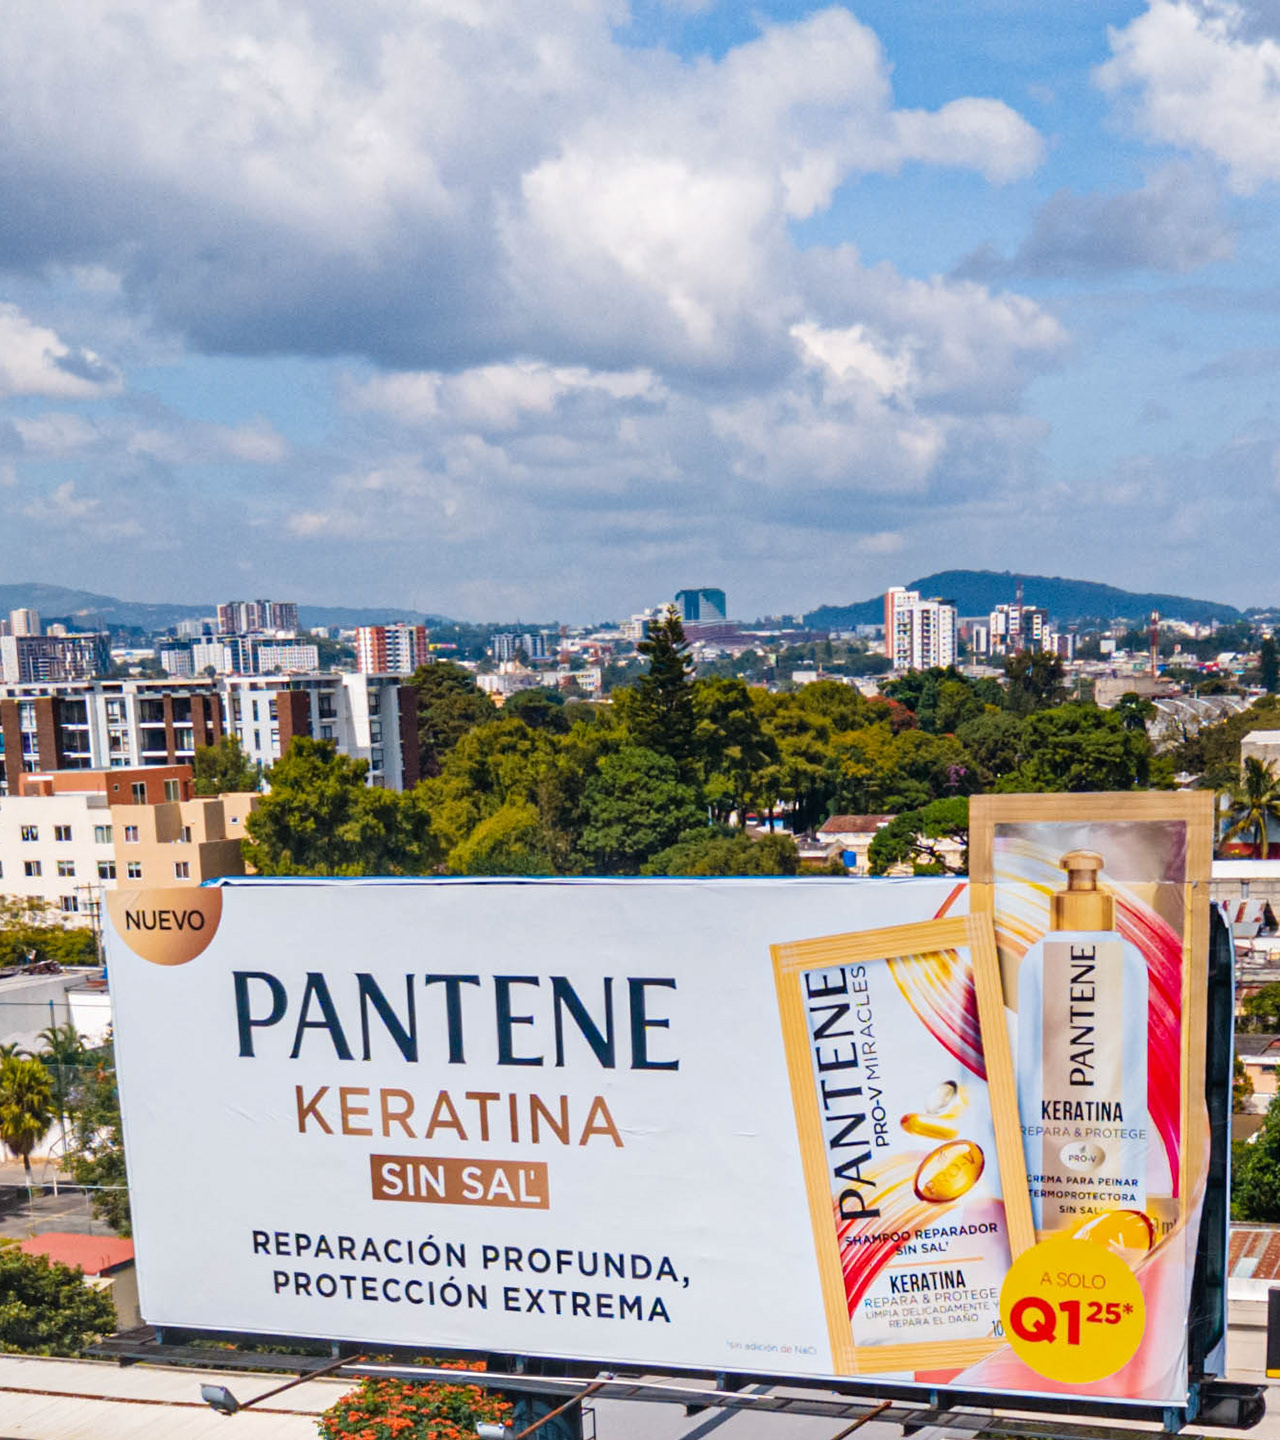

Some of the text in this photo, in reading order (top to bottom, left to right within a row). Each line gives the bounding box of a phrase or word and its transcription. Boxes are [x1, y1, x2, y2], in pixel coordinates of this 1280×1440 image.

[125, 909, 206, 932] NUEVO
[232, 970, 680, 1071] PANTENE
[1070, 945, 1096, 1086] PANTENE
[851, 965, 891, 1148] PRO-V MIRACLES
[805, 967, 881, 1221] PANTENE
[295, 1084, 625, 1148] KERATINA
[1041, 1100, 1124, 1122] KERATINA
[1020, 1125, 1147, 1140] REPARA & PROTEGE
[1068, 1154, 1098, 1164] PRO-V
[381, 1162, 446, 1198] SIN
[1066, 1175, 1094, 1186] PARA
[1098, 1177, 1139, 1187] PEINAR
[1028, 1188, 1136, 1202] TERMOPROTECTORA
[1059, 1205, 1077, 1214] SIN
[845, 1222, 999, 1247] SHAMPOO REPARADOR
[252, 1229, 691, 1289] REPARACIÓN PROFUNDA,
[896, 1242, 918, 1257] SIN
[890, 1269, 967, 1295] KERATINA
[1040, 1272, 1107, 1290] A SOLO
[274, 1269, 672, 1324] PROTECCIÓN EXTREMA
[864, 1295, 918, 1309] REPARA
[934, 1287, 998, 1303] PROTEGE
[865, 1308, 899, 1320] LIMPIA
[902, 1301, 990, 1317] DELICADAMENTE
[888, 1315, 930, 1329] REPARA
